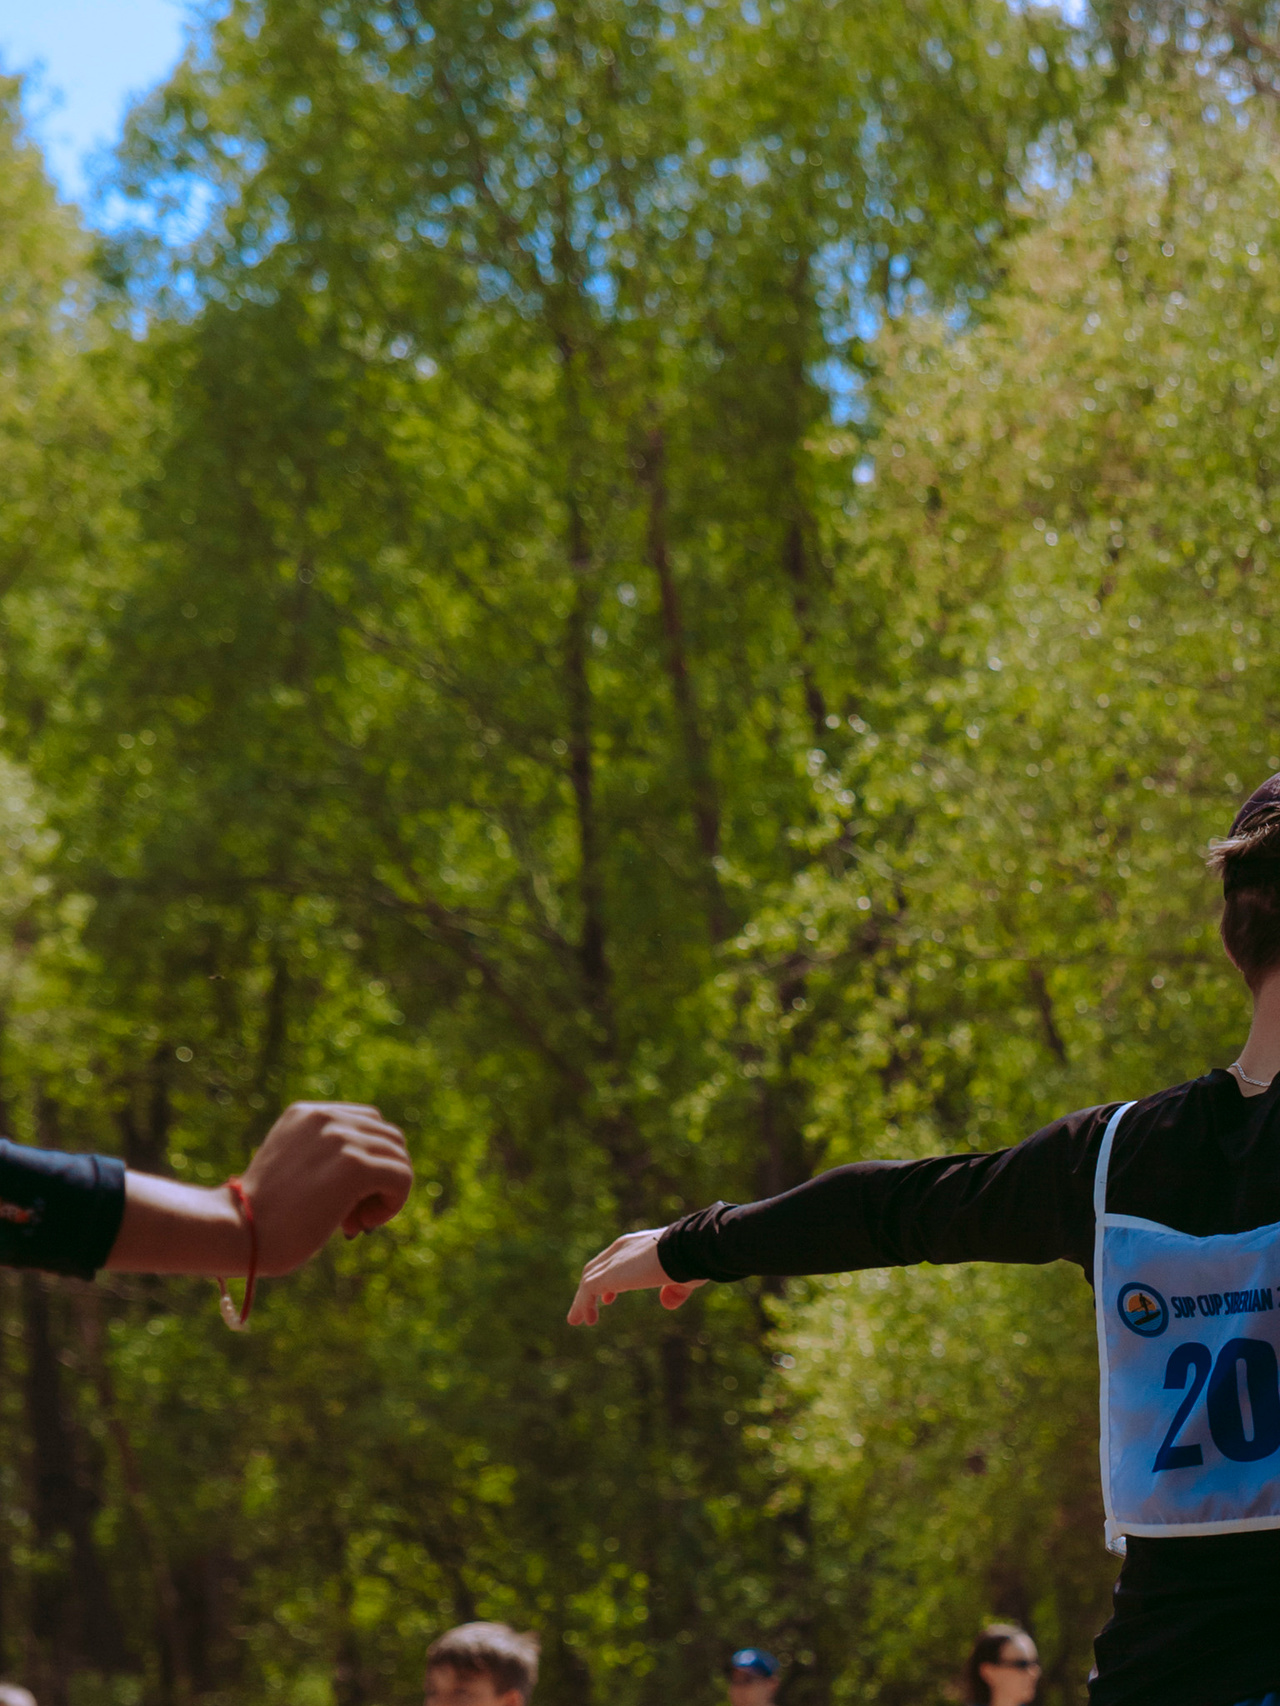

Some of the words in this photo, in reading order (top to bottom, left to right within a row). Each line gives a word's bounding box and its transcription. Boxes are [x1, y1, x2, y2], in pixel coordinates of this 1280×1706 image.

[1170, 1296, 1197, 1319] SUP
[1197, 1294, 1223, 1317] CUP
[1223, 1287, 1274, 1315] SIBERIAN
